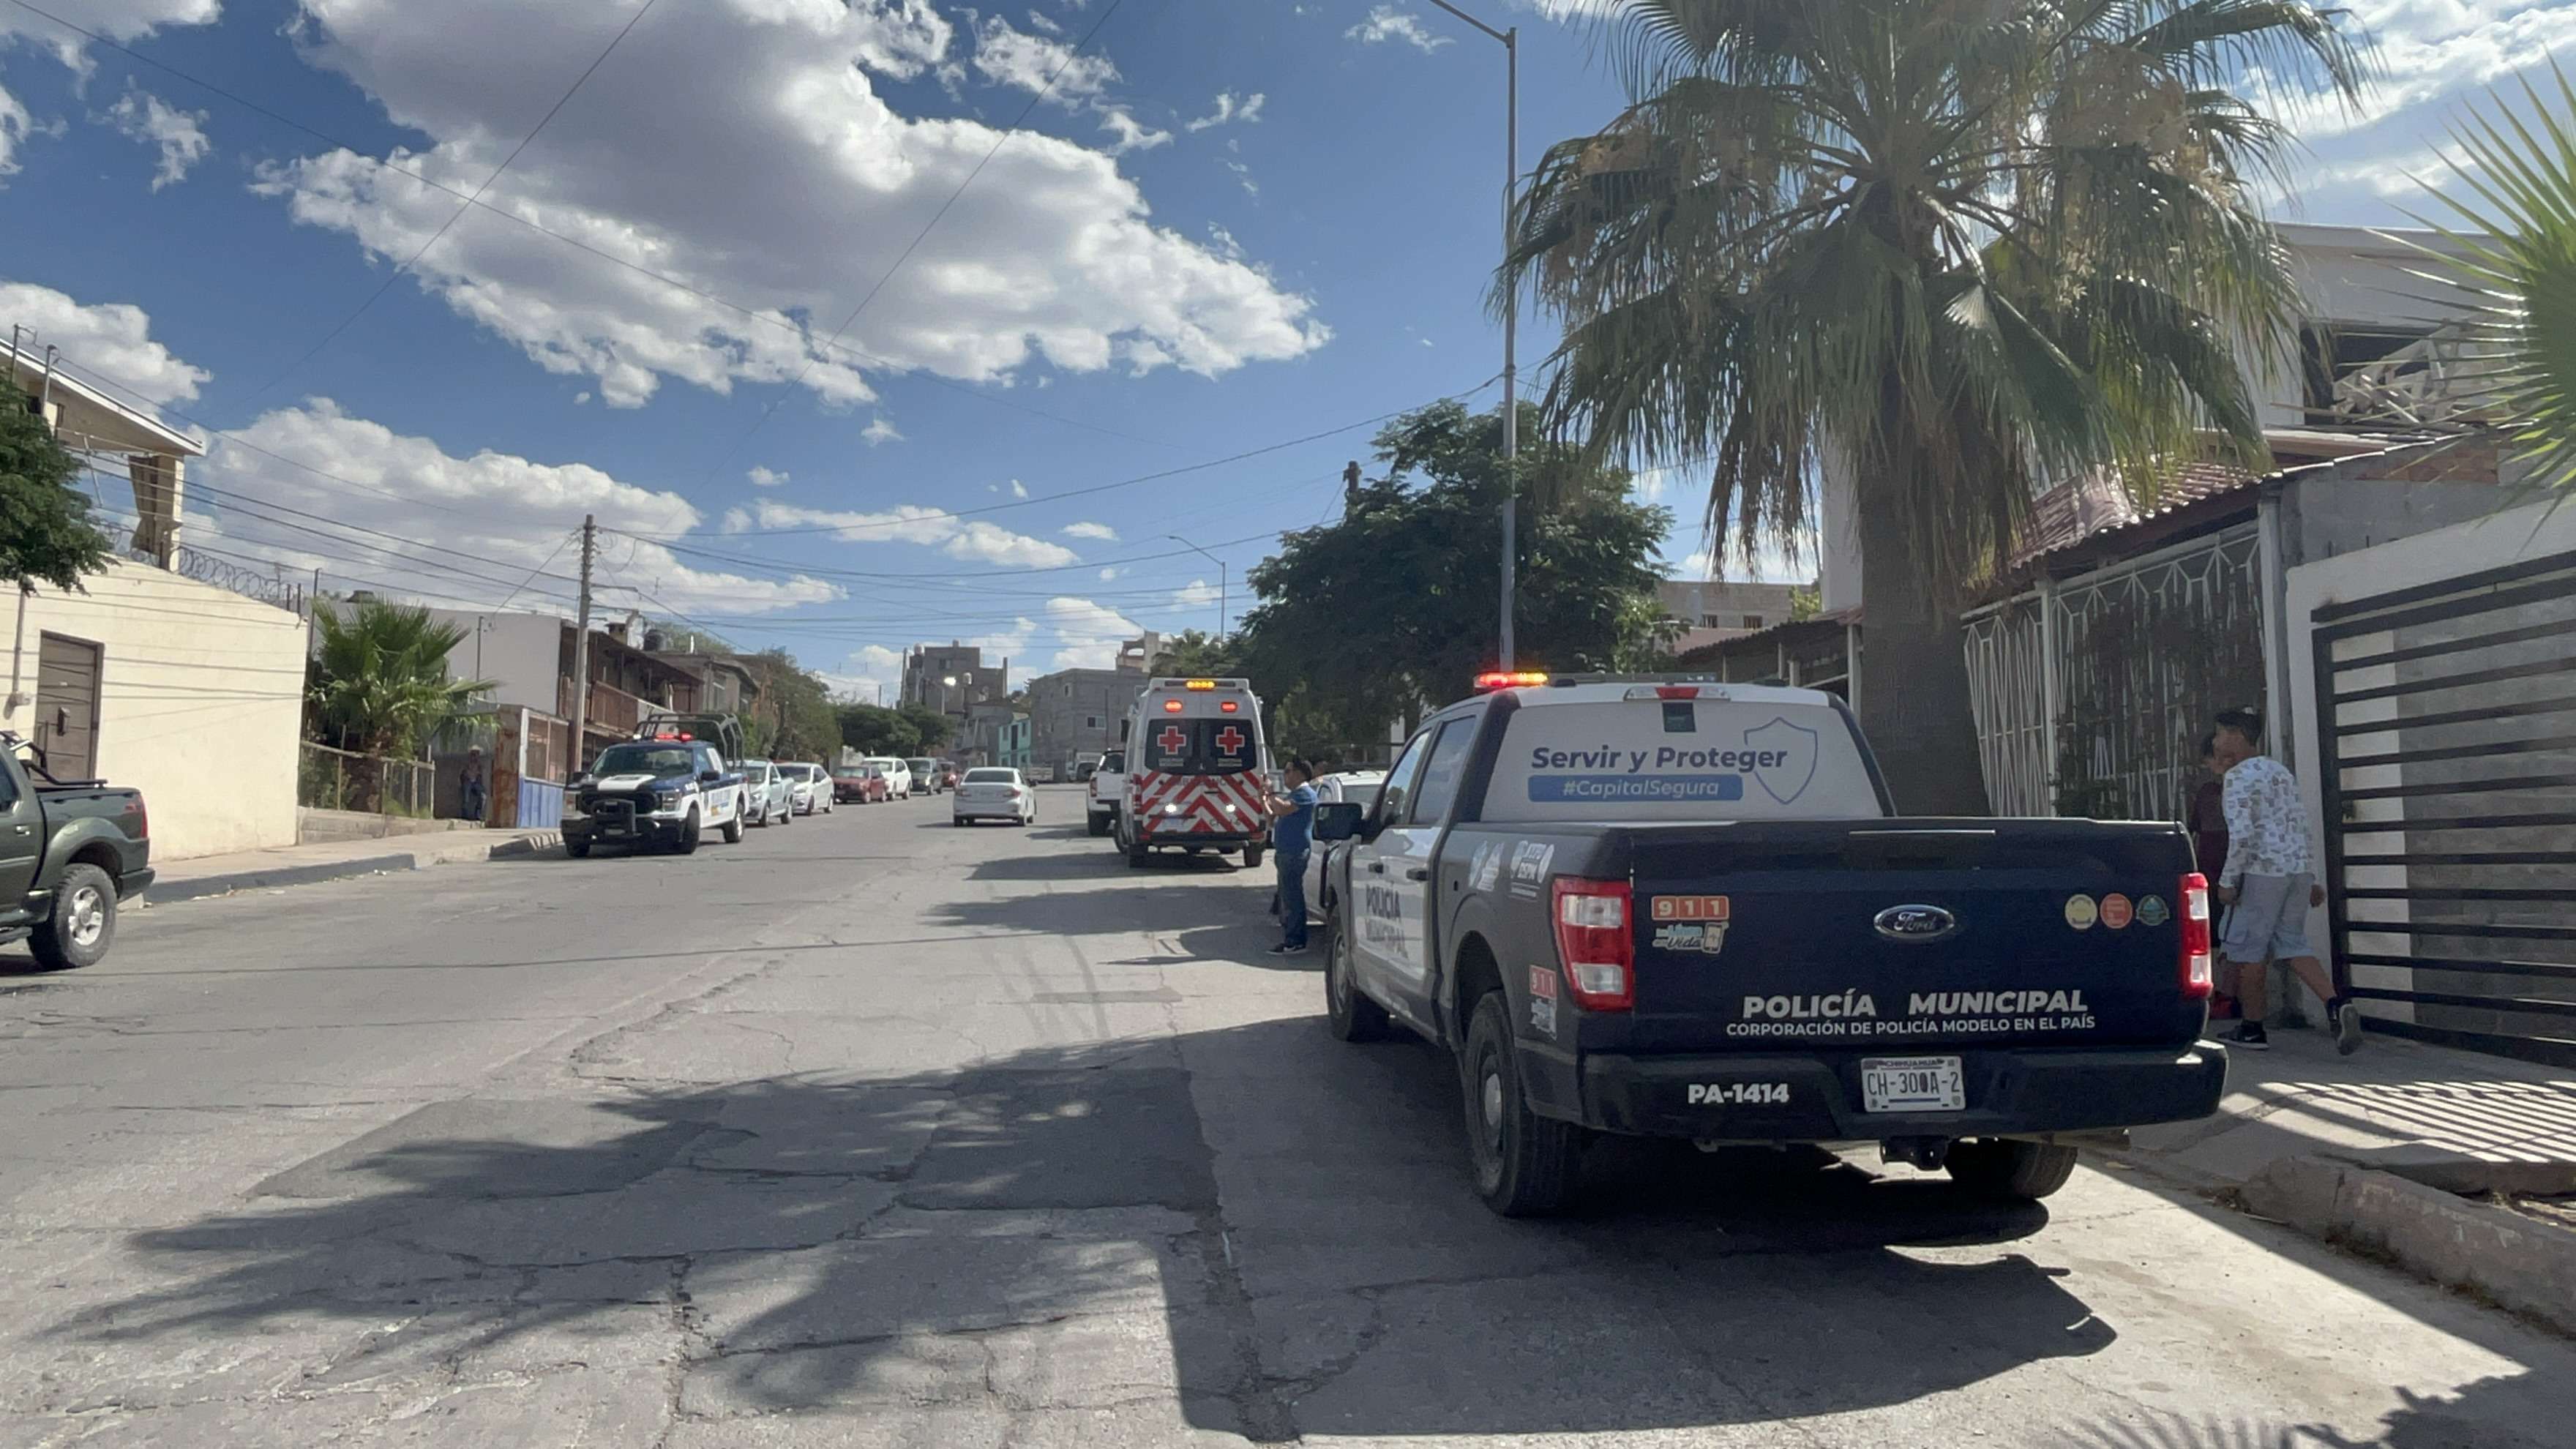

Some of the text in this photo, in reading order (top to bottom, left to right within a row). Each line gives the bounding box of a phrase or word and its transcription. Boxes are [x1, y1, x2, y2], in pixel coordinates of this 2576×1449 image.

[1532, 745, 1788, 774] Servir y Proteger
[1563, 779, 1720, 798] #CapitalSegura
[1658, 900, 1721, 916] 911
[1893, 911, 1938, 932] Ford
[1743, 988, 2088, 1019] POLICÍA MUNICIPAL
[1726, 1013, 2095, 1036] CORPORACIÓN DE POLICÍA MODELO EN EL PAÍS
[1688, 1083, 1789, 1104] PA-1414
